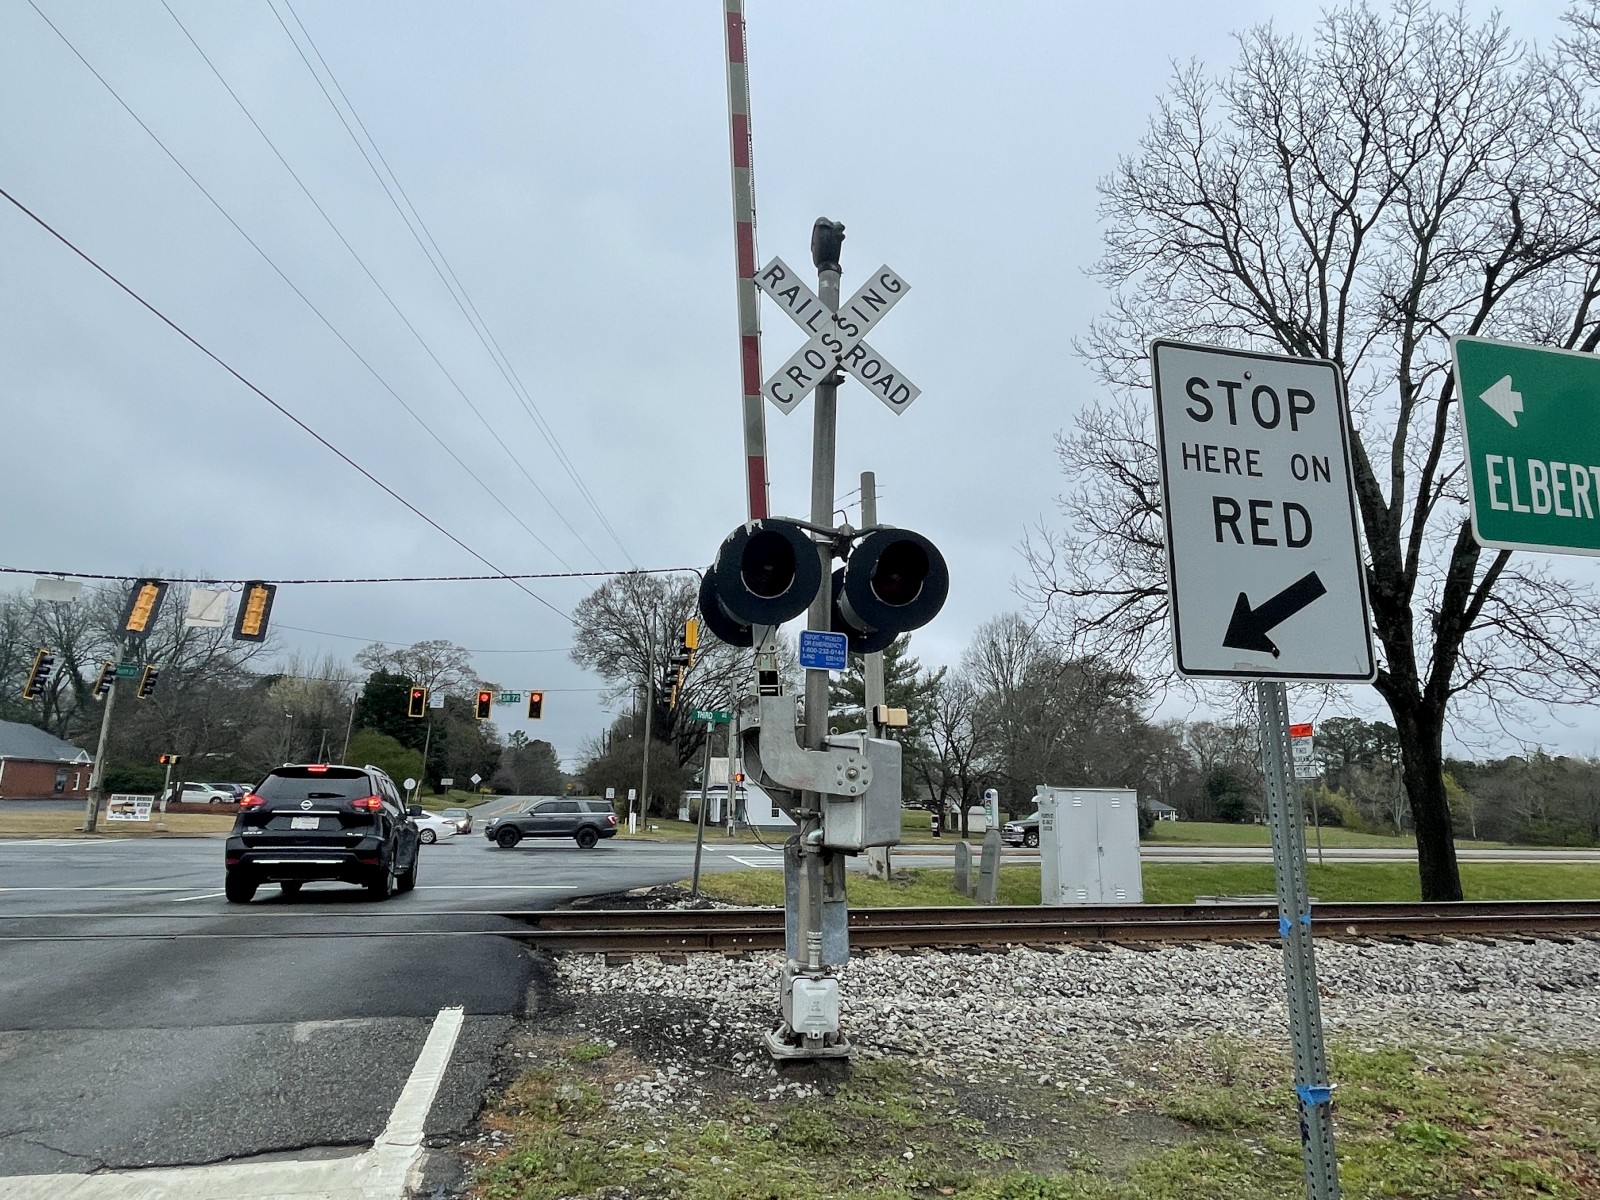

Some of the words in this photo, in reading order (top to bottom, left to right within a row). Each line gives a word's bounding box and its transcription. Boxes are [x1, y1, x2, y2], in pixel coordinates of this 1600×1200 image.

[1185, 376, 1316, 432] STOP
[1181, 442, 1263, 478] HERE
[1290, 453, 1332, 484] ON
[1212, 495, 1313, 549] RED
[502, 694, 511, 702] SR
[511, 694, 520, 702] 72
[697, 711, 714, 720] THIRD
